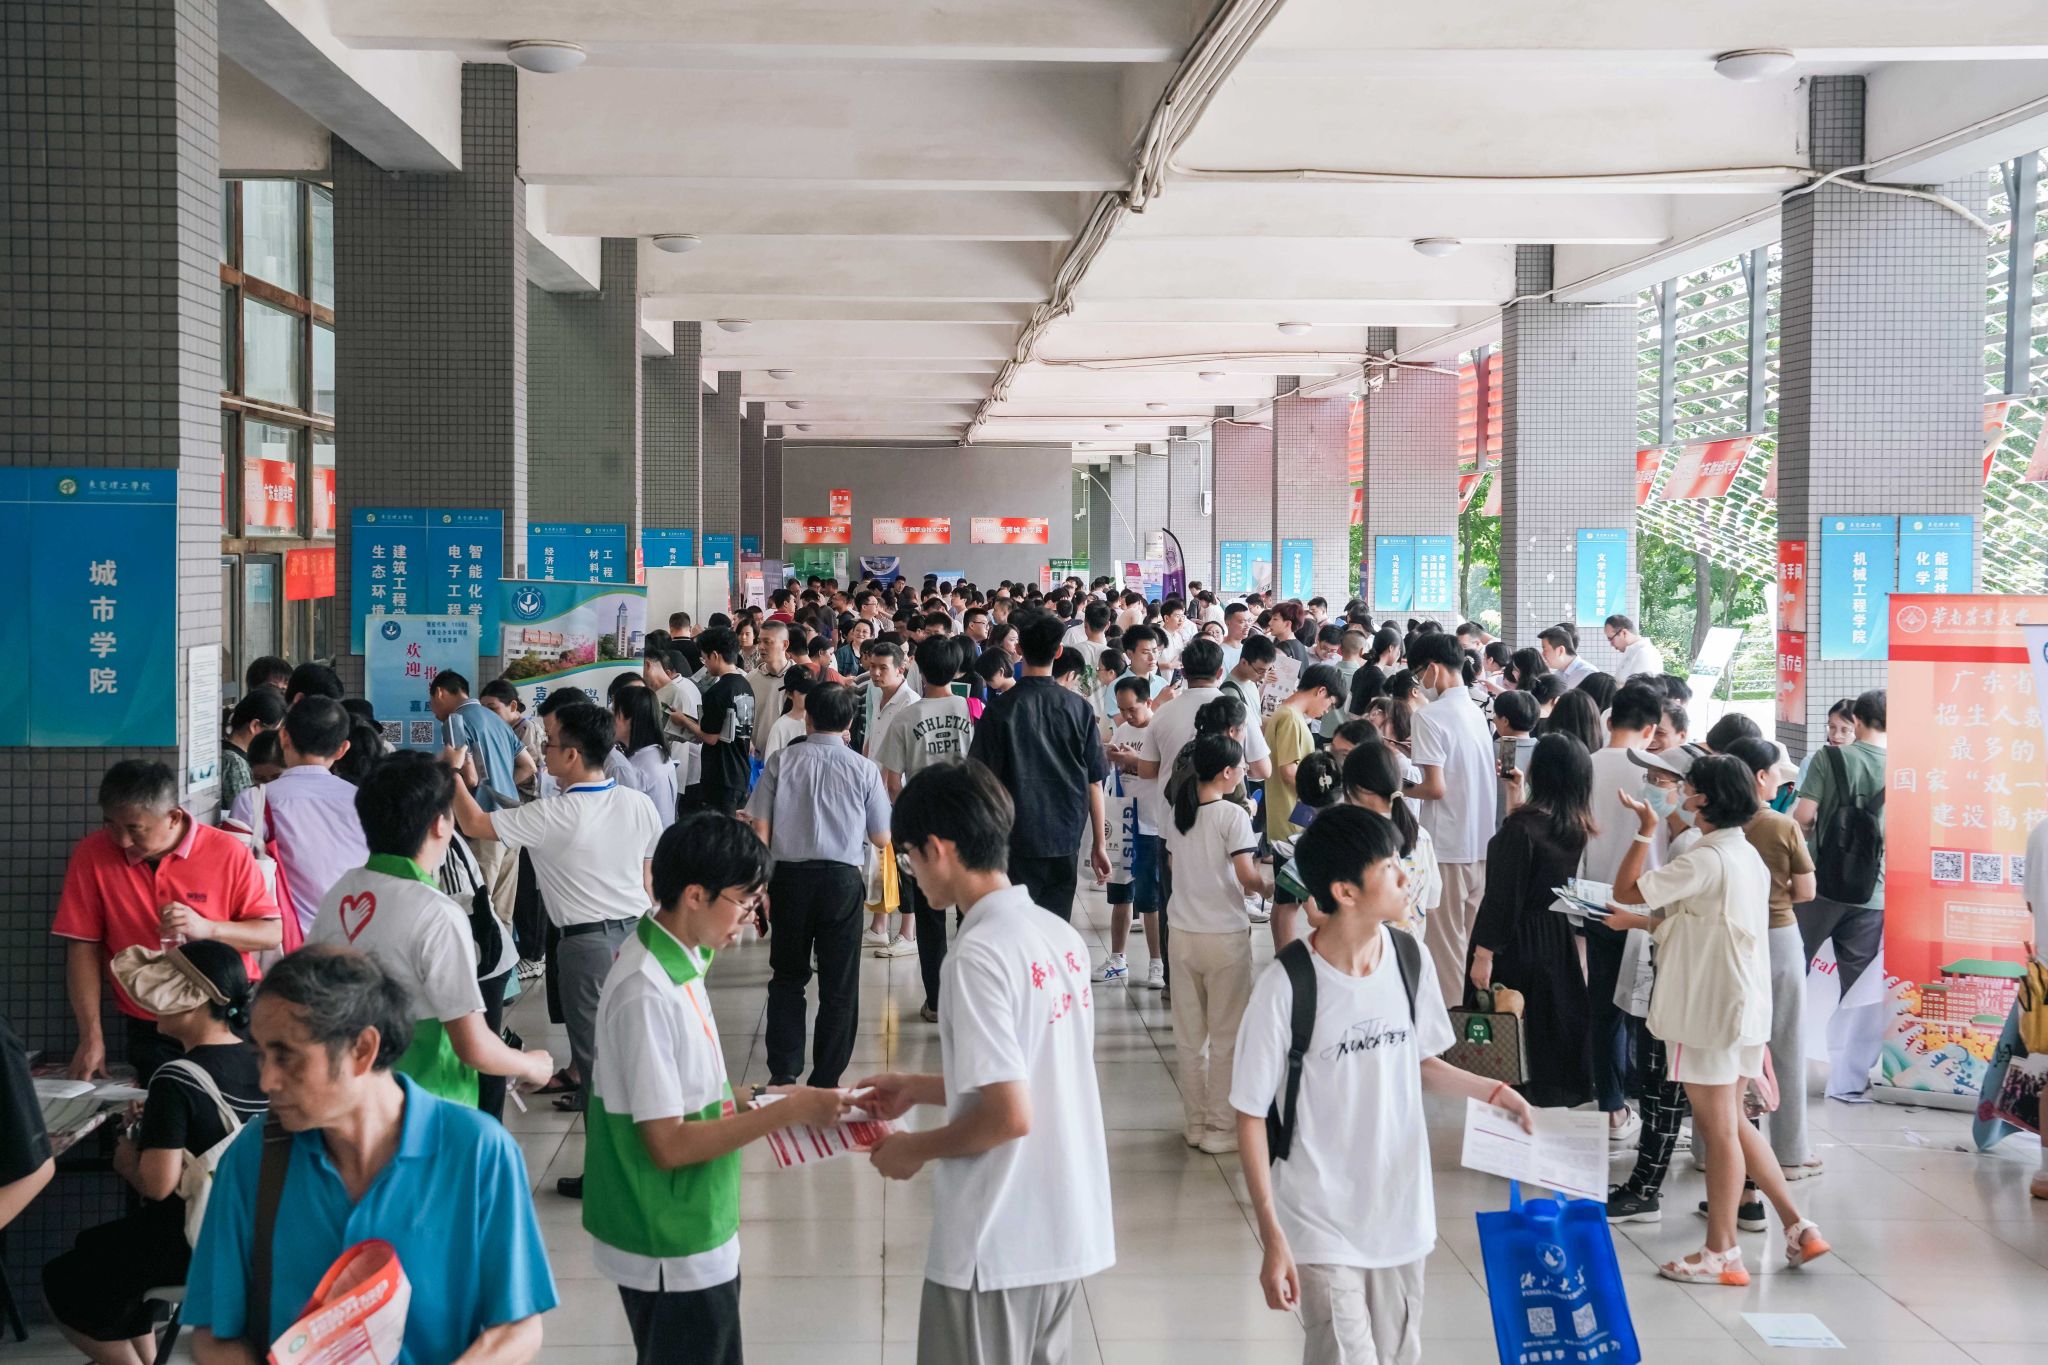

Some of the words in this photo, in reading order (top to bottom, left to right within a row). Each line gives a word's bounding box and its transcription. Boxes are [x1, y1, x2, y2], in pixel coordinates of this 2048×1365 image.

[603, 549, 613, 578] 工程
[1779, 562, 1803, 580] 洗手间
[1915, 551, 1931, 593] 化学
[372, 544, 386, 616] 生态环境
[447, 544, 462, 616] 电子工程
[1852, 551, 1867, 644] 机械工程学院
[89, 560, 117, 693] 城市学院
[405, 642, 422, 677] 欢迎
[1779, 654, 1803, 673] 医疗点
[1951, 670, 2033, 695] 广东省
[913, 715, 971, 740] ATHLETIC
[928, 739, 961, 754] DEPT.
[1950, 736, 2035, 763] 最多的
[1123, 806, 1136, 872] GZIST
